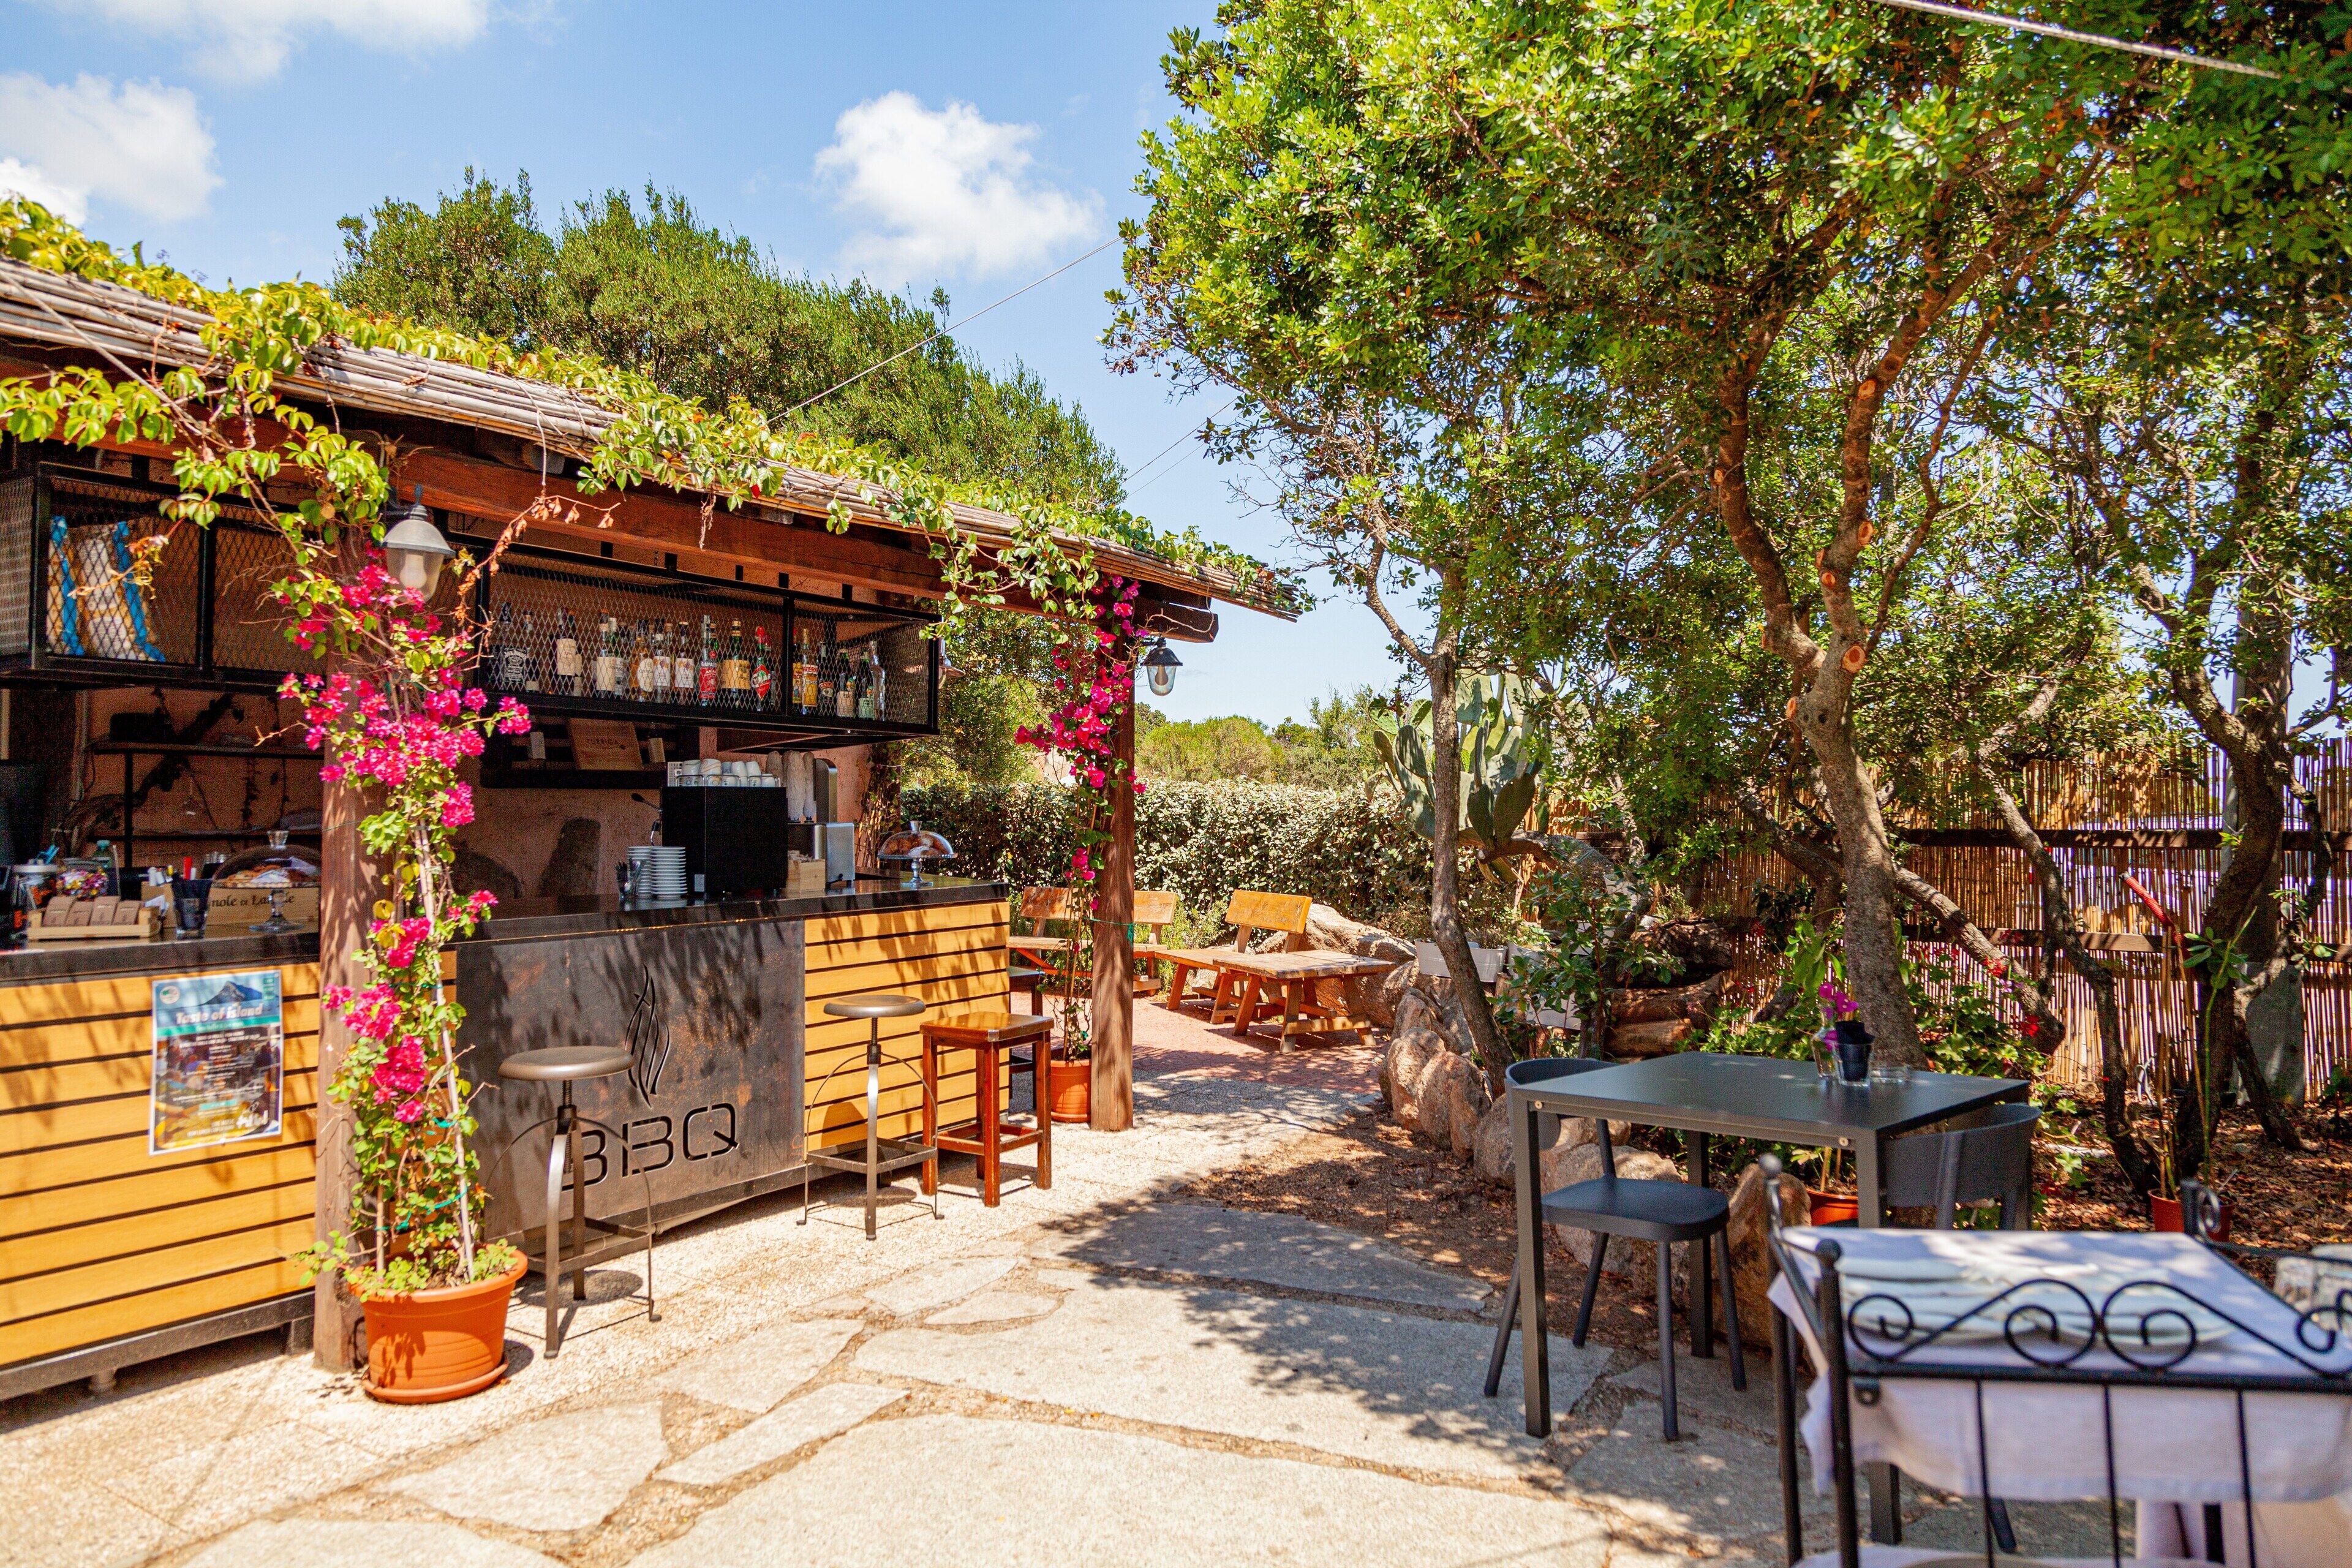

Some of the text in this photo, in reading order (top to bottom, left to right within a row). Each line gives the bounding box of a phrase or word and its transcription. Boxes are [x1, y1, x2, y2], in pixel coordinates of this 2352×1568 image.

[176, 1011, 209, 1024] Taste
[211, 1008, 225, 1020] of
[552, 1102, 739, 1191] BBQ
